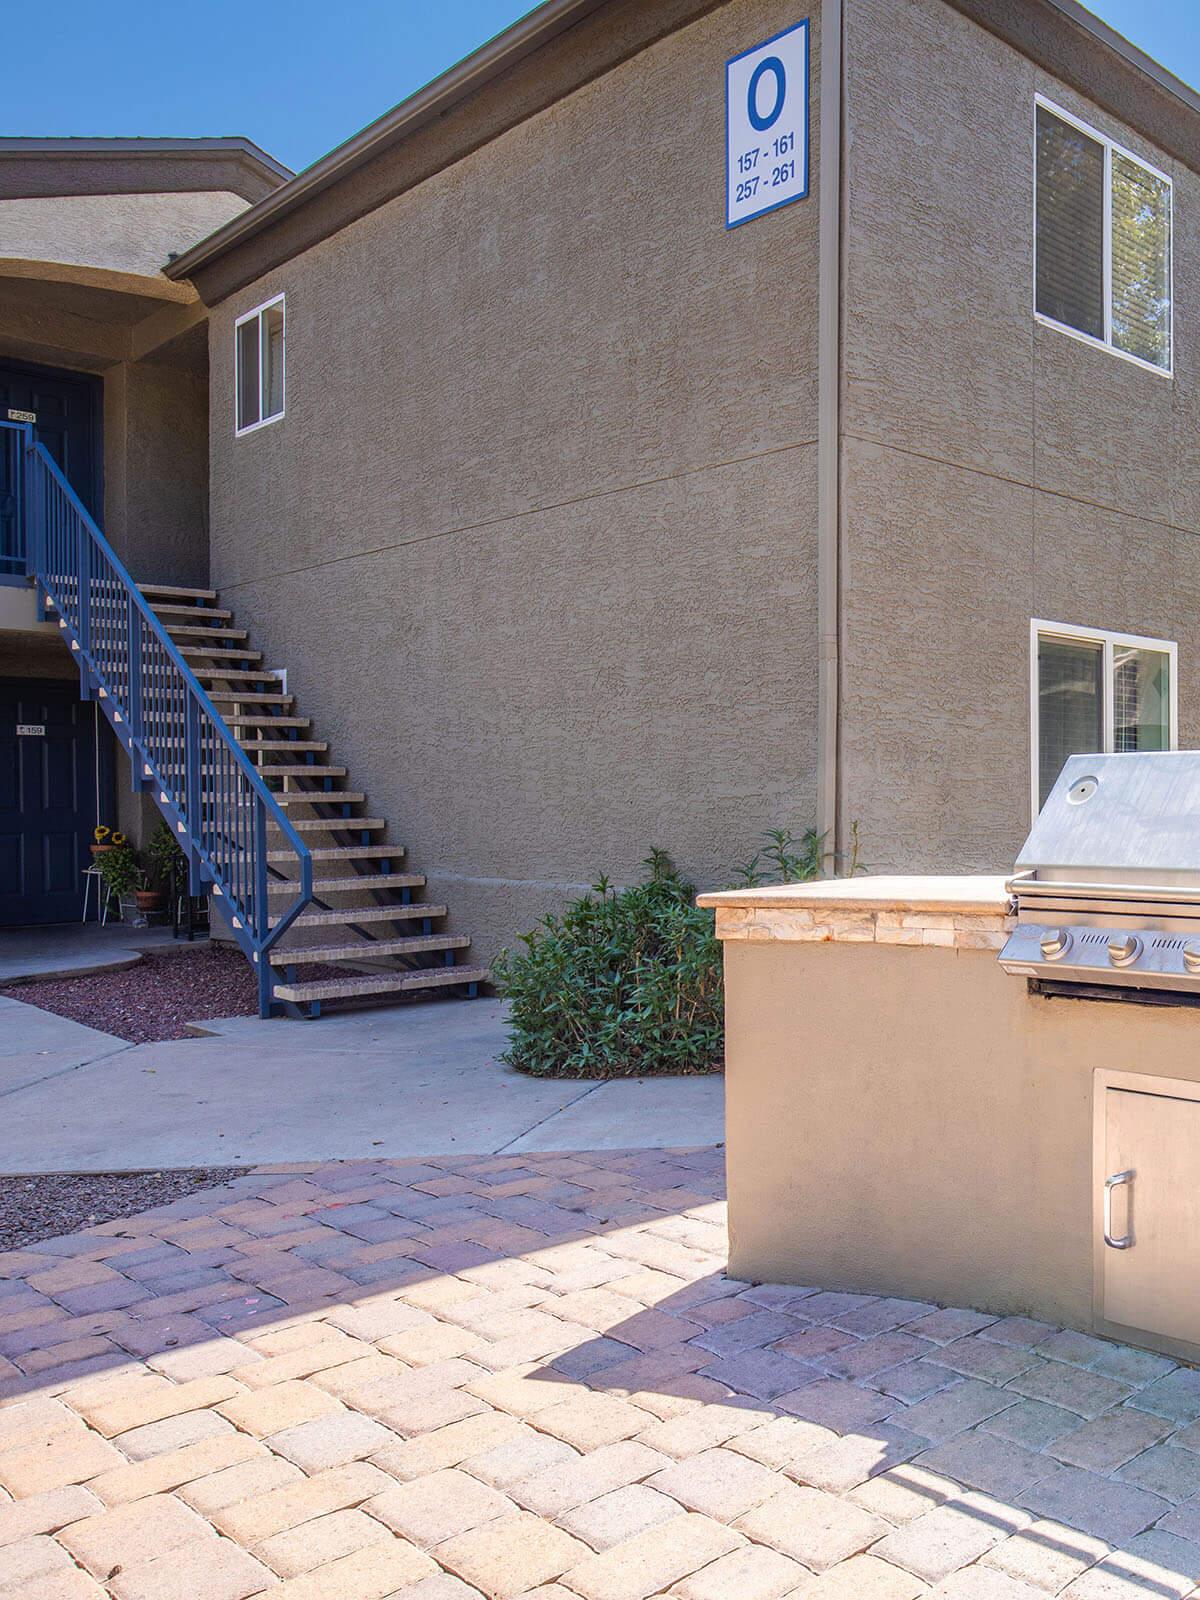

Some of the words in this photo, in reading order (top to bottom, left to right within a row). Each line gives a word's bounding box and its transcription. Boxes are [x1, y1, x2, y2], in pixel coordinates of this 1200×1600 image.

[748, 56, 786, 131] O
[737, 148, 760, 173] 157
[772, 132, 794, 157] 161
[736, 176, 760, 202] 257
[772, 160, 795, 186] 261
